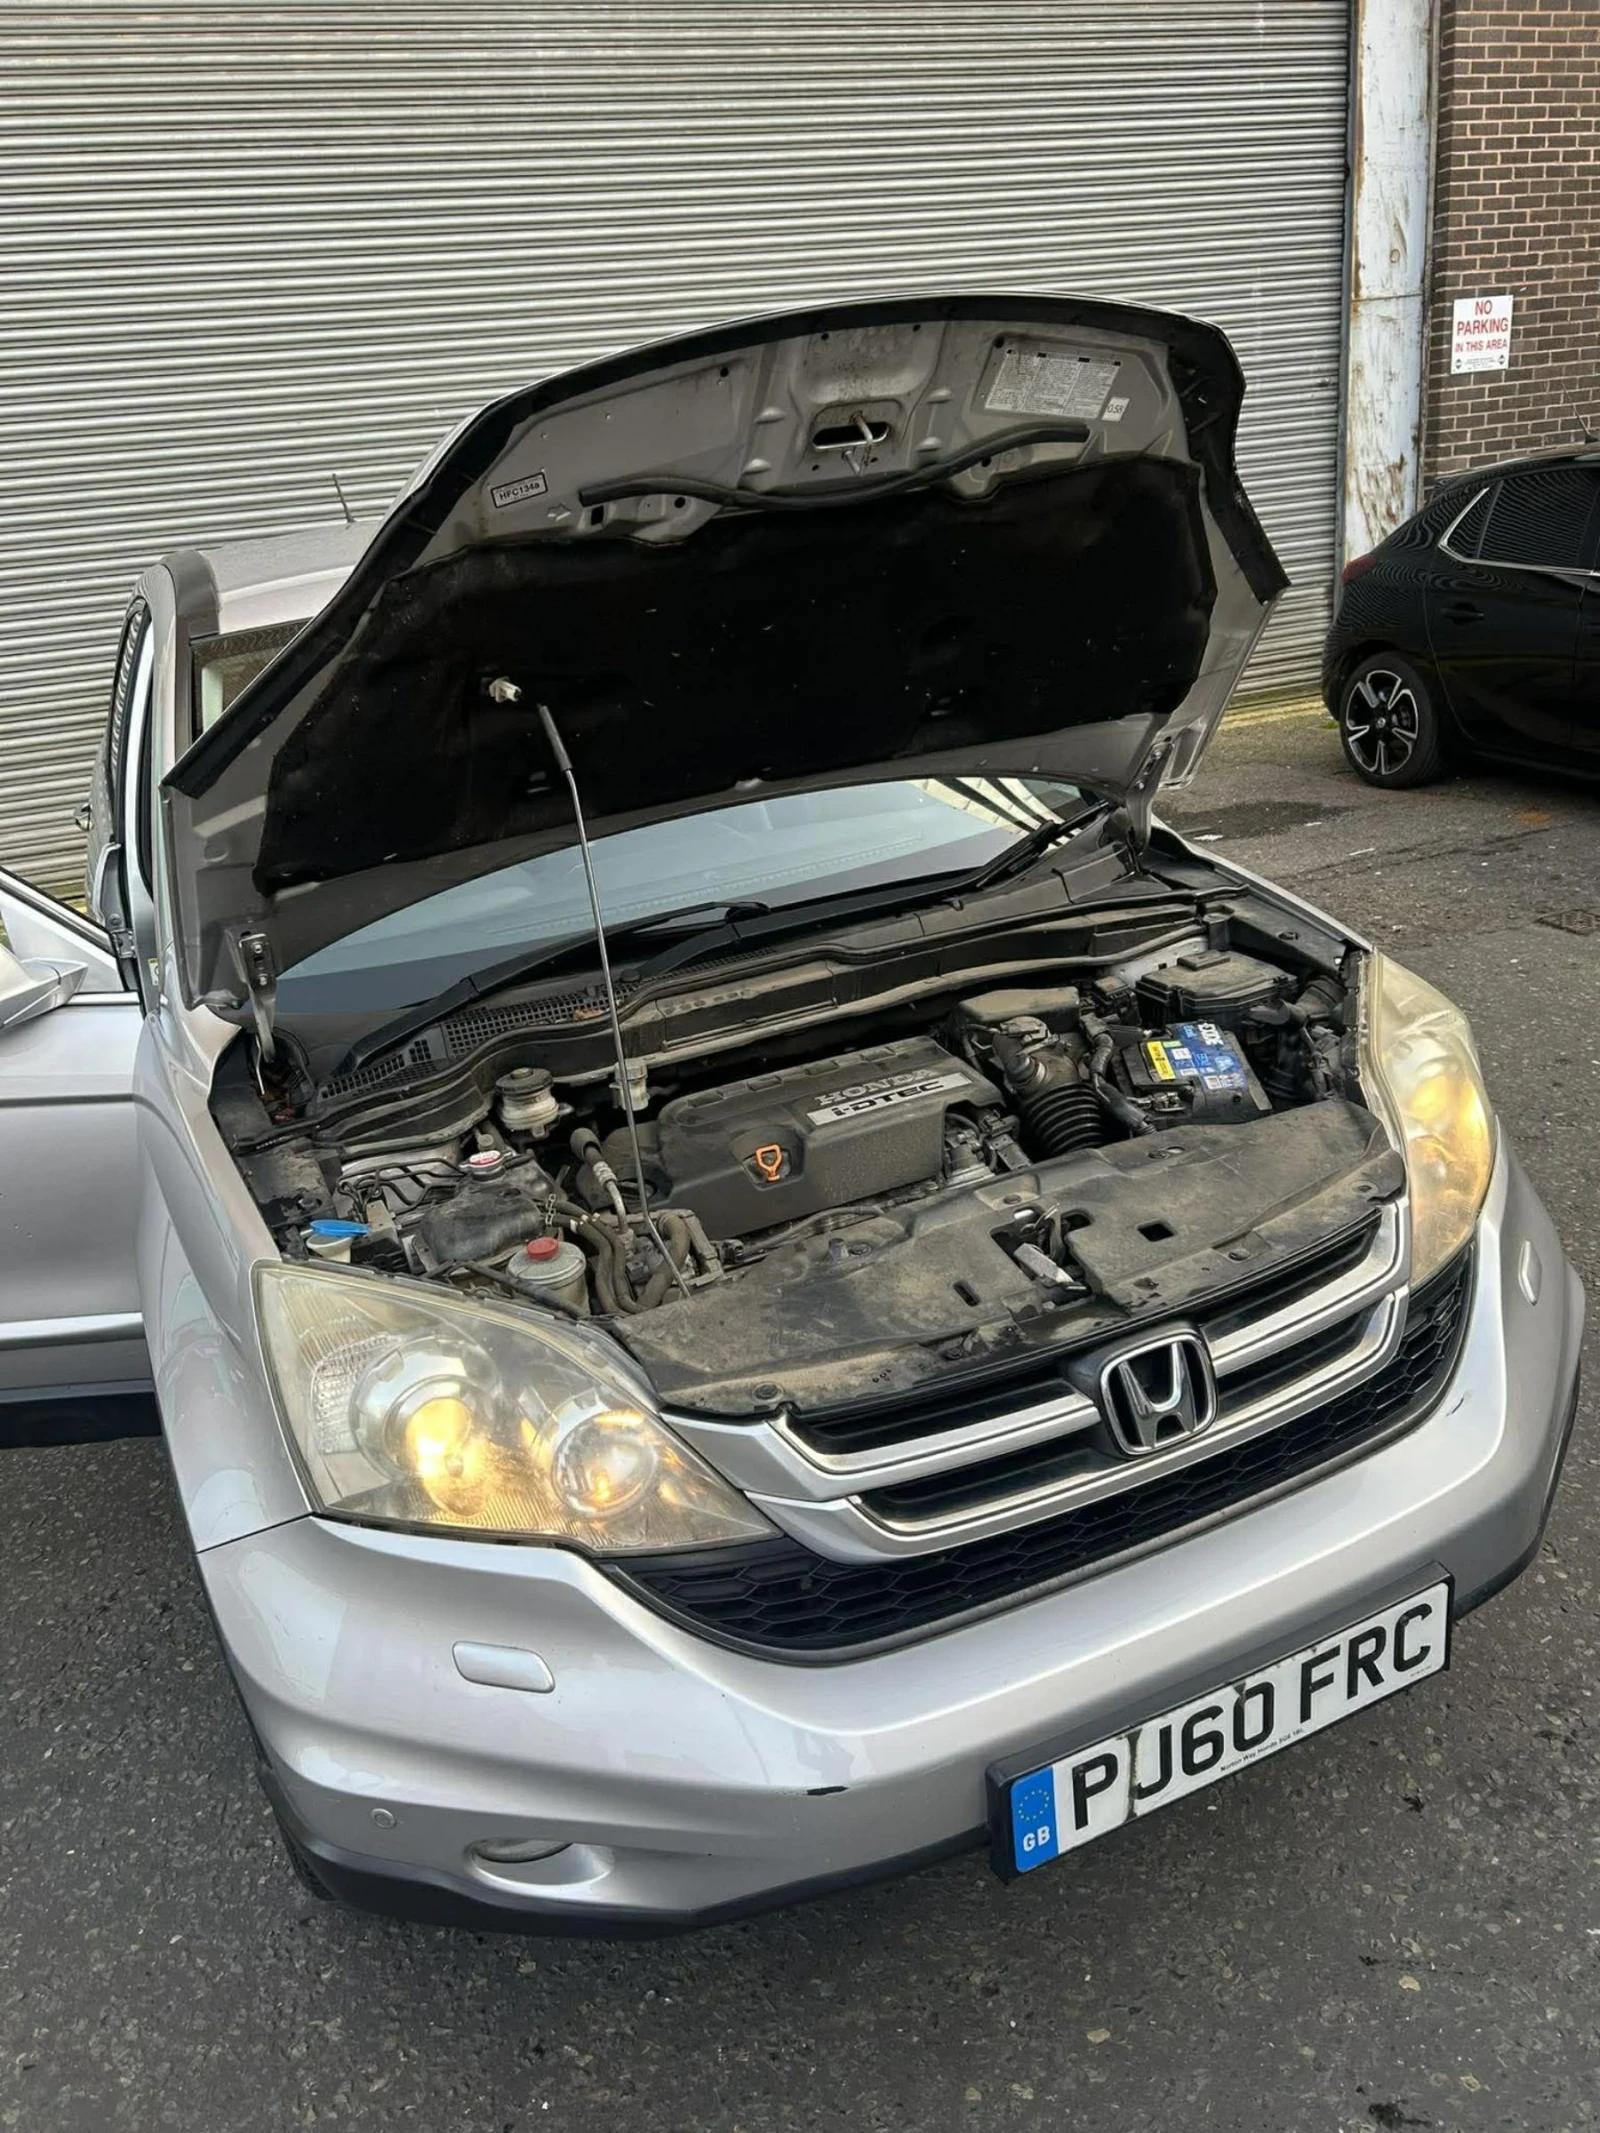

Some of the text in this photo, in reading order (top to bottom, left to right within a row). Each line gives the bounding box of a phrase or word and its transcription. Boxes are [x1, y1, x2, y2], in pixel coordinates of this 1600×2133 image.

[1475, 300, 1492, 315] NO
[1457, 317, 1509, 335] PARKING
[1455, 338, 1507, 352] IN THIS AREA
[499, 482, 540, 501] HFC134a
[815, 1068, 940, 1106] HONDA
[832, 1081, 944, 1116] i-DTEC
[1071, 1603, 1433, 1830] PJ60 FRC
[1023, 1825, 1051, 1852] GB
